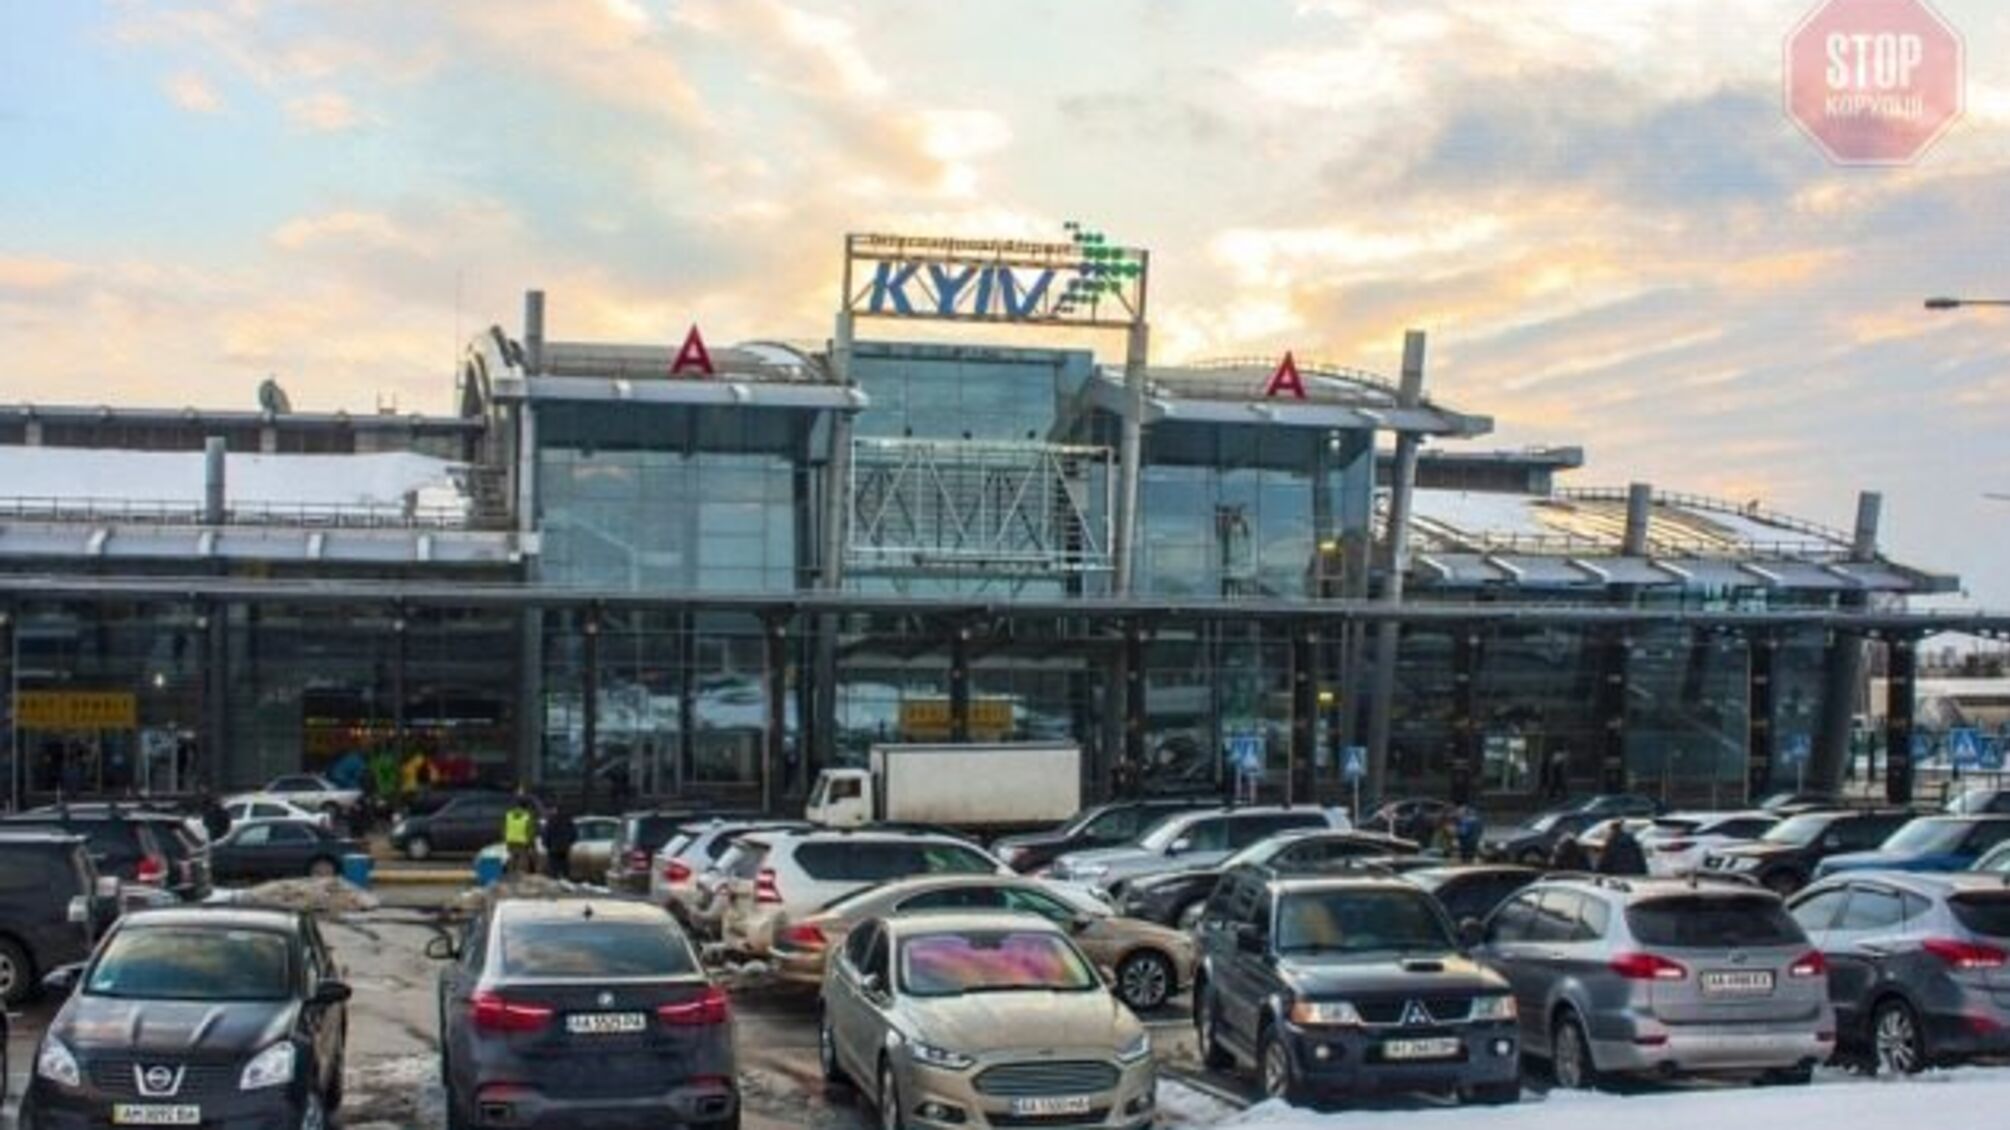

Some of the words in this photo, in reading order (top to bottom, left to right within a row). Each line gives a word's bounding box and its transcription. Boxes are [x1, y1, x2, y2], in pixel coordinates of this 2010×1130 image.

[869, 261, 1056, 317] KYIV
[671, 322, 715, 375] A
[1266, 350, 1306, 399] A
